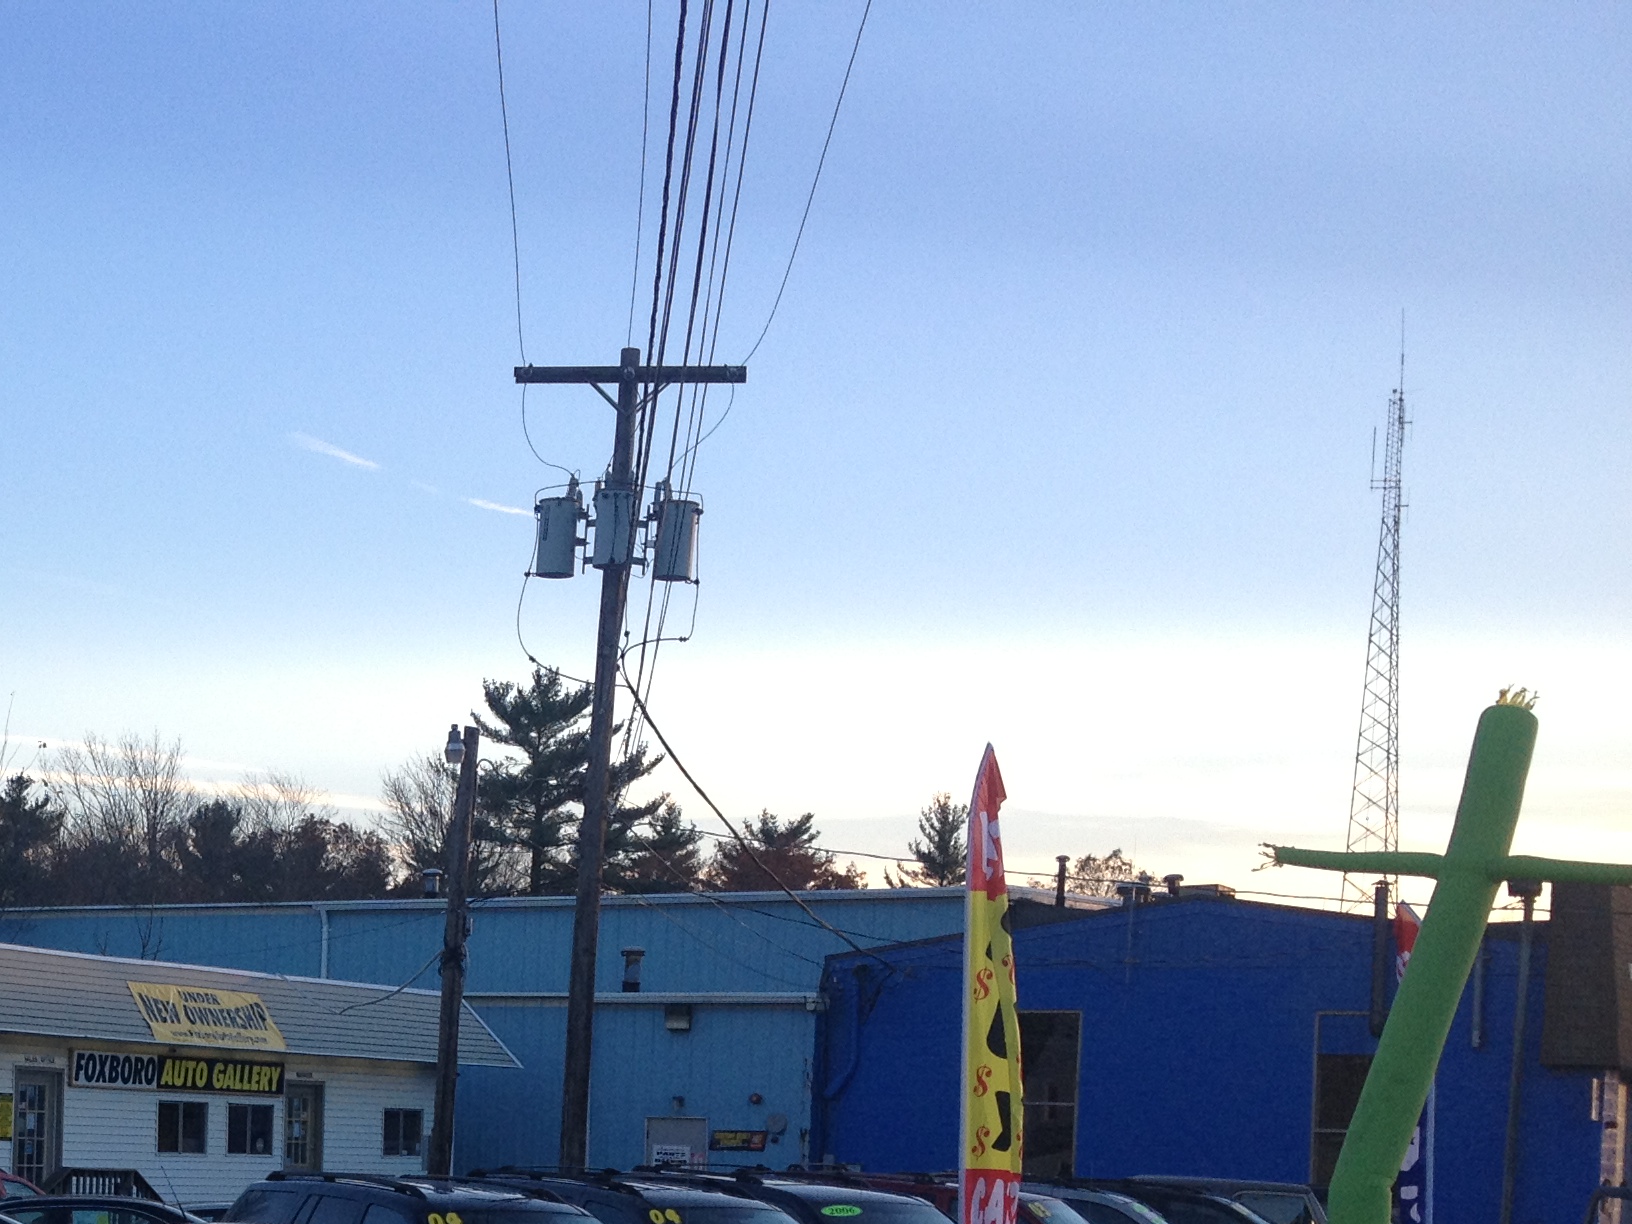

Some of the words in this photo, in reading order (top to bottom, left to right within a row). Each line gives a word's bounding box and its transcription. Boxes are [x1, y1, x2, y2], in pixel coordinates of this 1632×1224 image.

[177, 990, 221, 1006] UNDER
[138, 993, 182, 1025] NEW
[183, 1002, 268, 1031] OWNERSHIP
[74, 1051, 156, 1086] FOXBORO
[160, 1058, 209, 1088] AUTO
[212, 1062, 282, 1093] GALLERY
[828, 1206, 856, 1216] 2006
